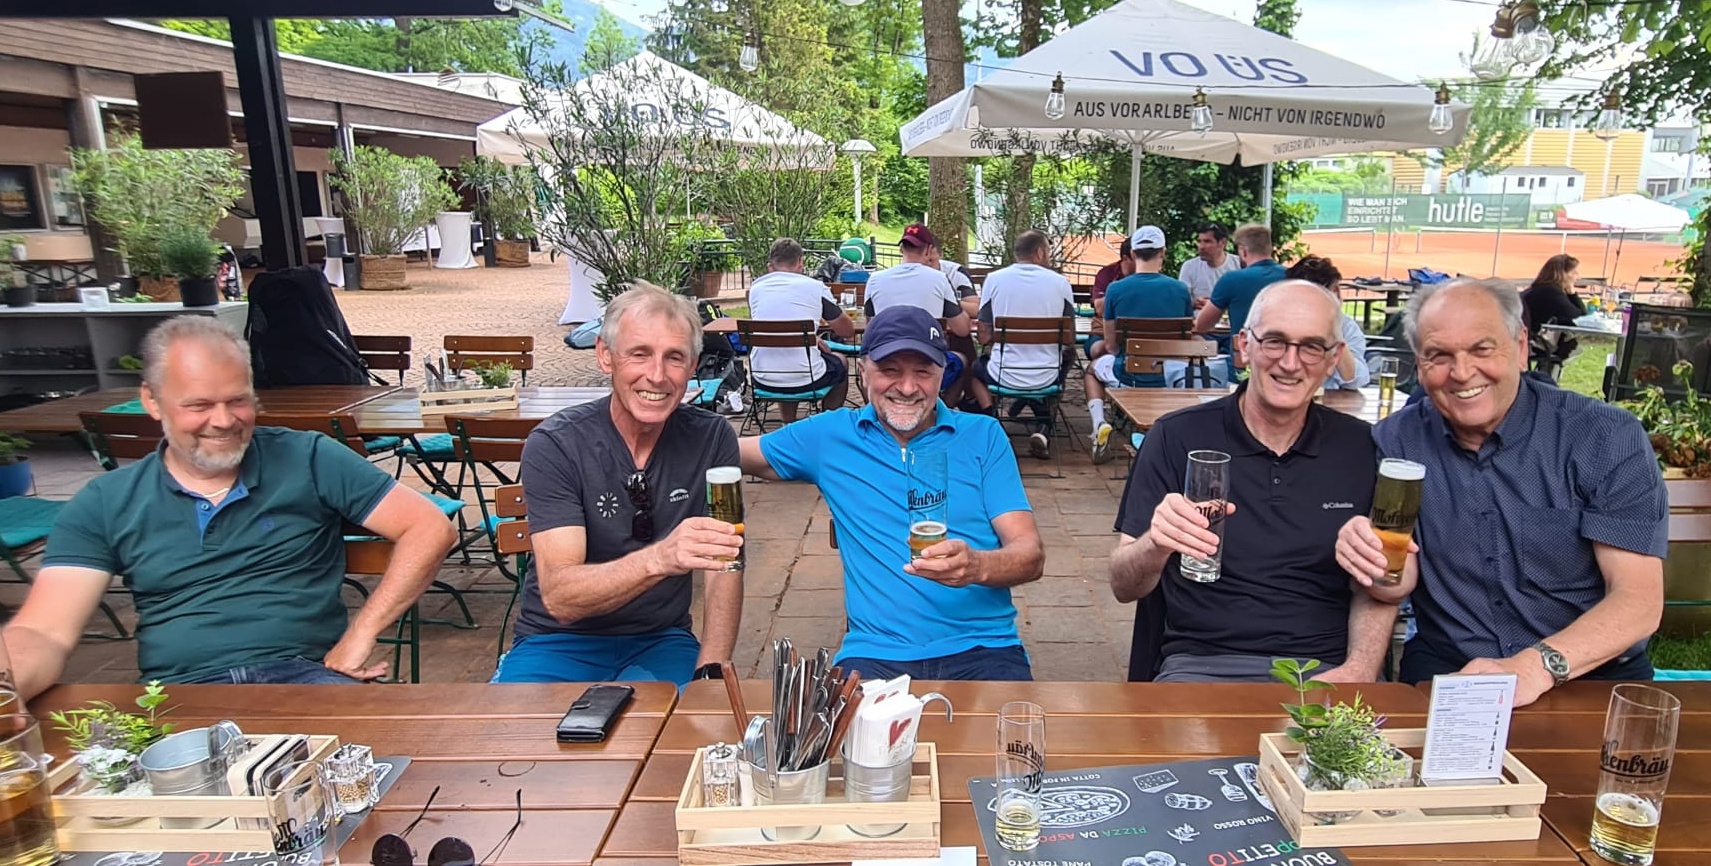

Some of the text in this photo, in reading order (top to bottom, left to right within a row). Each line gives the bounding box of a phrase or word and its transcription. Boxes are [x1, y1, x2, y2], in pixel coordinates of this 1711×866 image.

[1110, 50, 1309, 84] VO ÜS
[1074, 102, 1105, 117] AUS
[1111, 102, 1212, 119] VORARLBE
[1228, 106, 1272, 122] NICHT
[1278, 108, 1306, 124] VON
[1310, 110, 1386, 129] IRGENDWO
[1348, 197, 1364, 206] WIE
[1366, 197, 1385, 206] MAN
[1428, 196, 1484, 223] hutle
[1073, 774, 1101, 782] COTTA
[1213, 815, 1274, 831] VINO ROSSO
[1039, 826, 1147, 843] PIZZA DA ASPO
